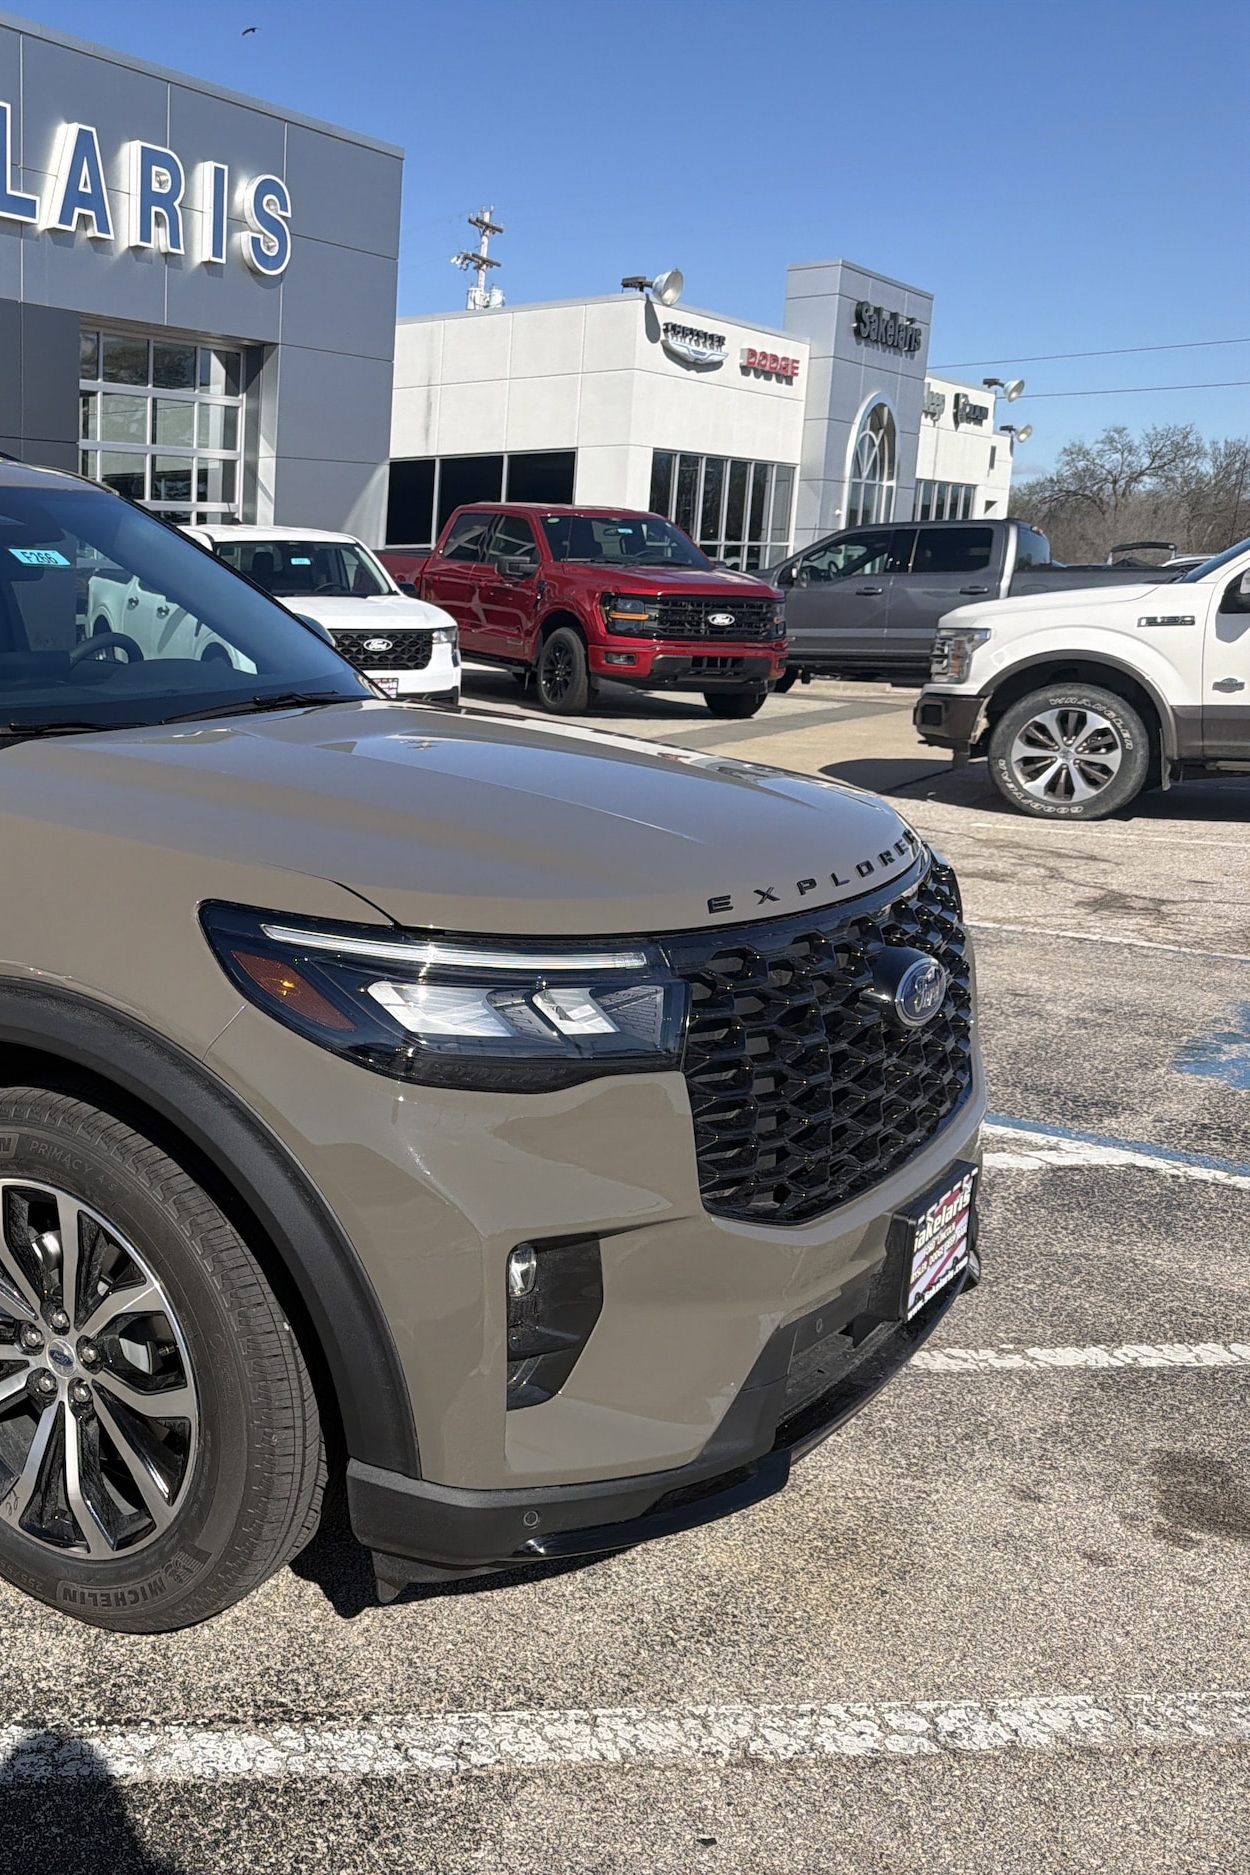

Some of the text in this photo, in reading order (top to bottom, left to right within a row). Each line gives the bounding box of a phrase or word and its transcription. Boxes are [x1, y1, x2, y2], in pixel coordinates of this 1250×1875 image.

[855, 301, 922, 352] Sakelaris
[741, 348, 800, 377] DODGE
[997, 758, 1084, 815] GOODYEAR
[30, 1140, 94, 1174] PRIMACY
[62, 1576, 167, 1608] MICHELIN
